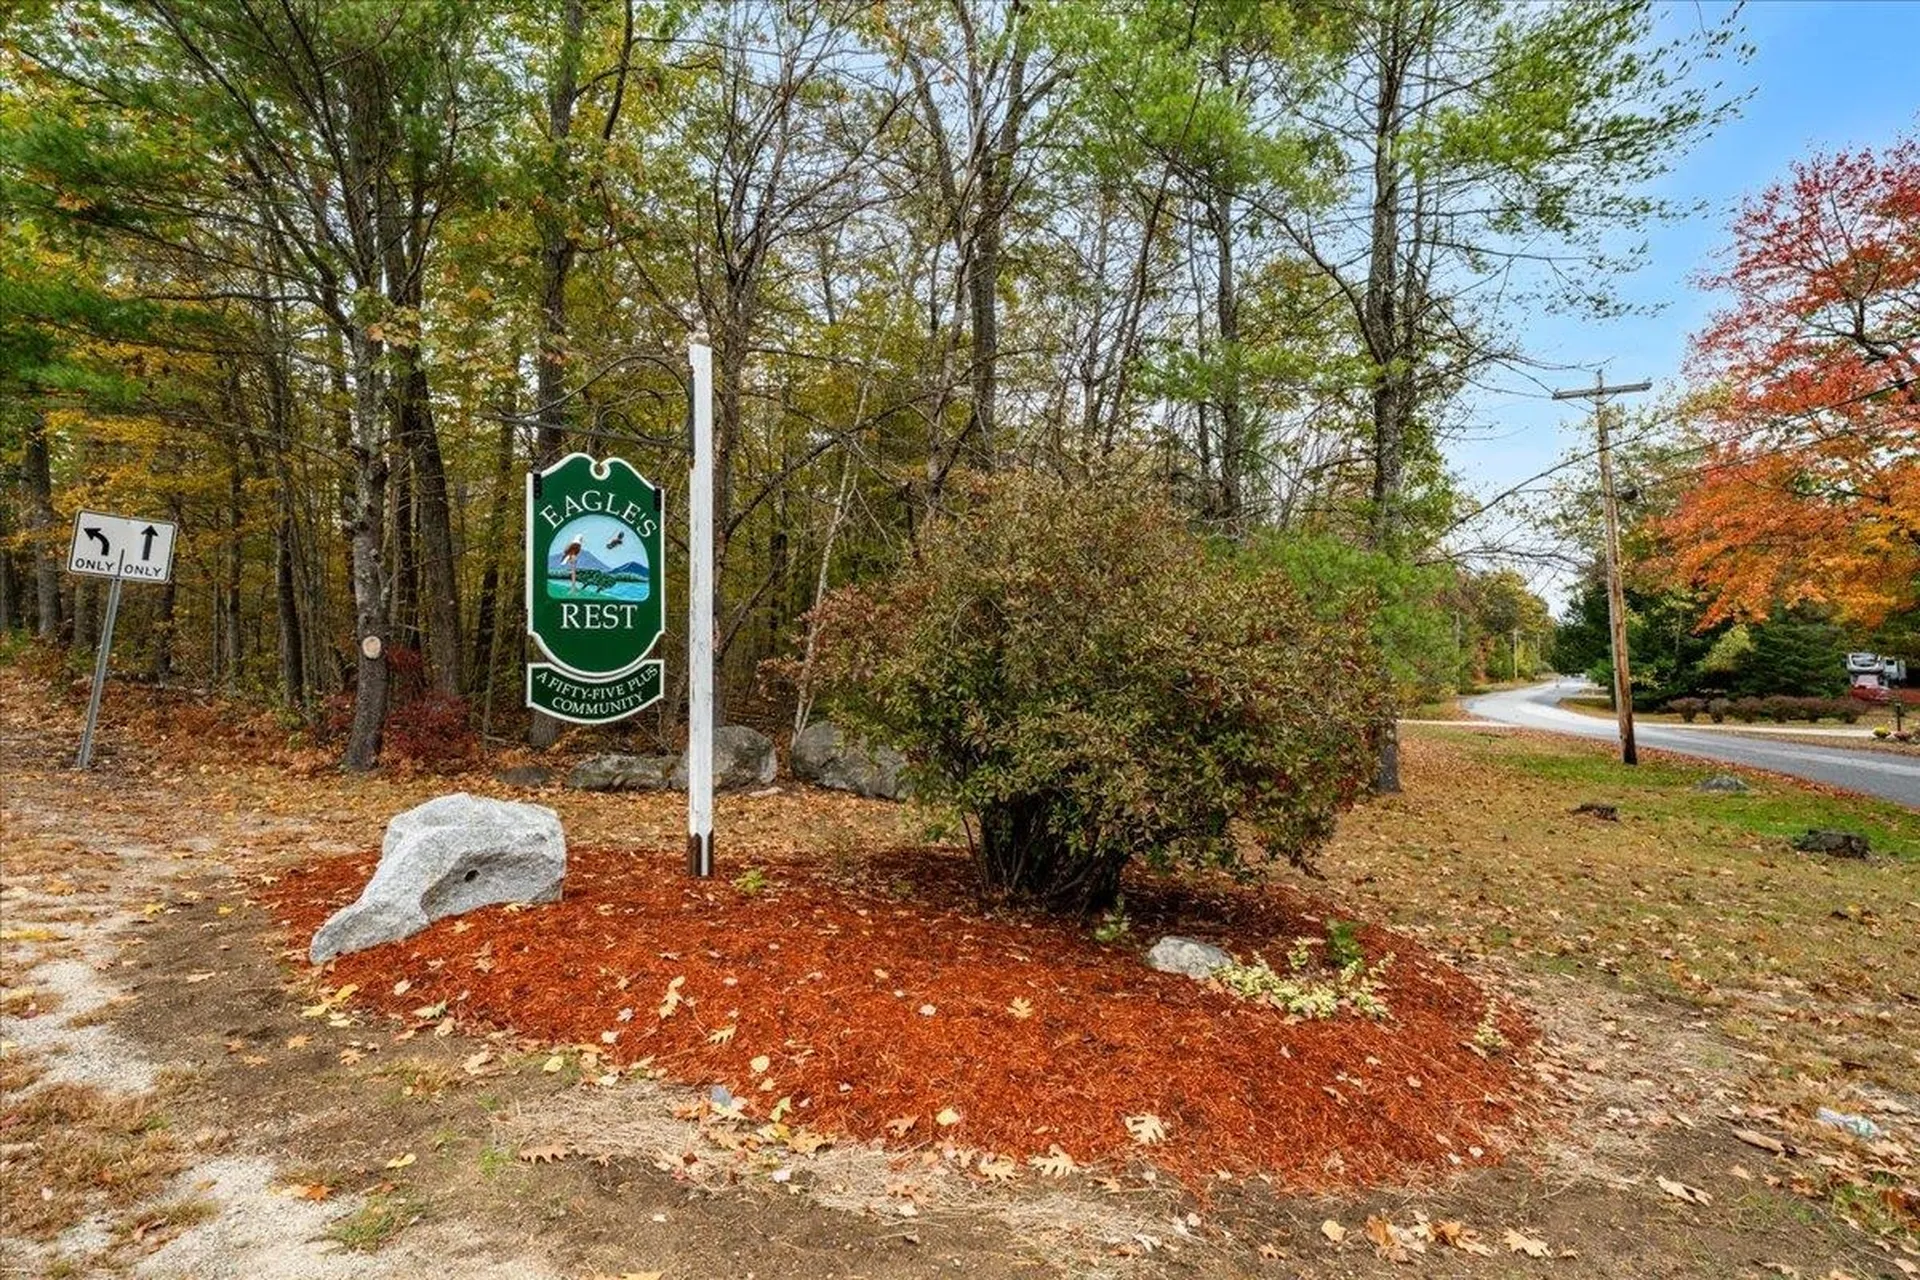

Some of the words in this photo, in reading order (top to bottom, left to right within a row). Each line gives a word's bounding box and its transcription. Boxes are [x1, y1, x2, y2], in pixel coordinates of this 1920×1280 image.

[539, 490, 657, 539] EAGLE'S
[75, 558, 114, 571] ONLY
[124, 564, 162, 577] ONLY
[560, 603, 638, 629] REST
[536, 670, 548, 685] A
[548, 676, 625, 700] FIFTY-FIVE
[627, 664, 659, 690] PLUS
[551, 691, 644, 715] COMMUNITY
